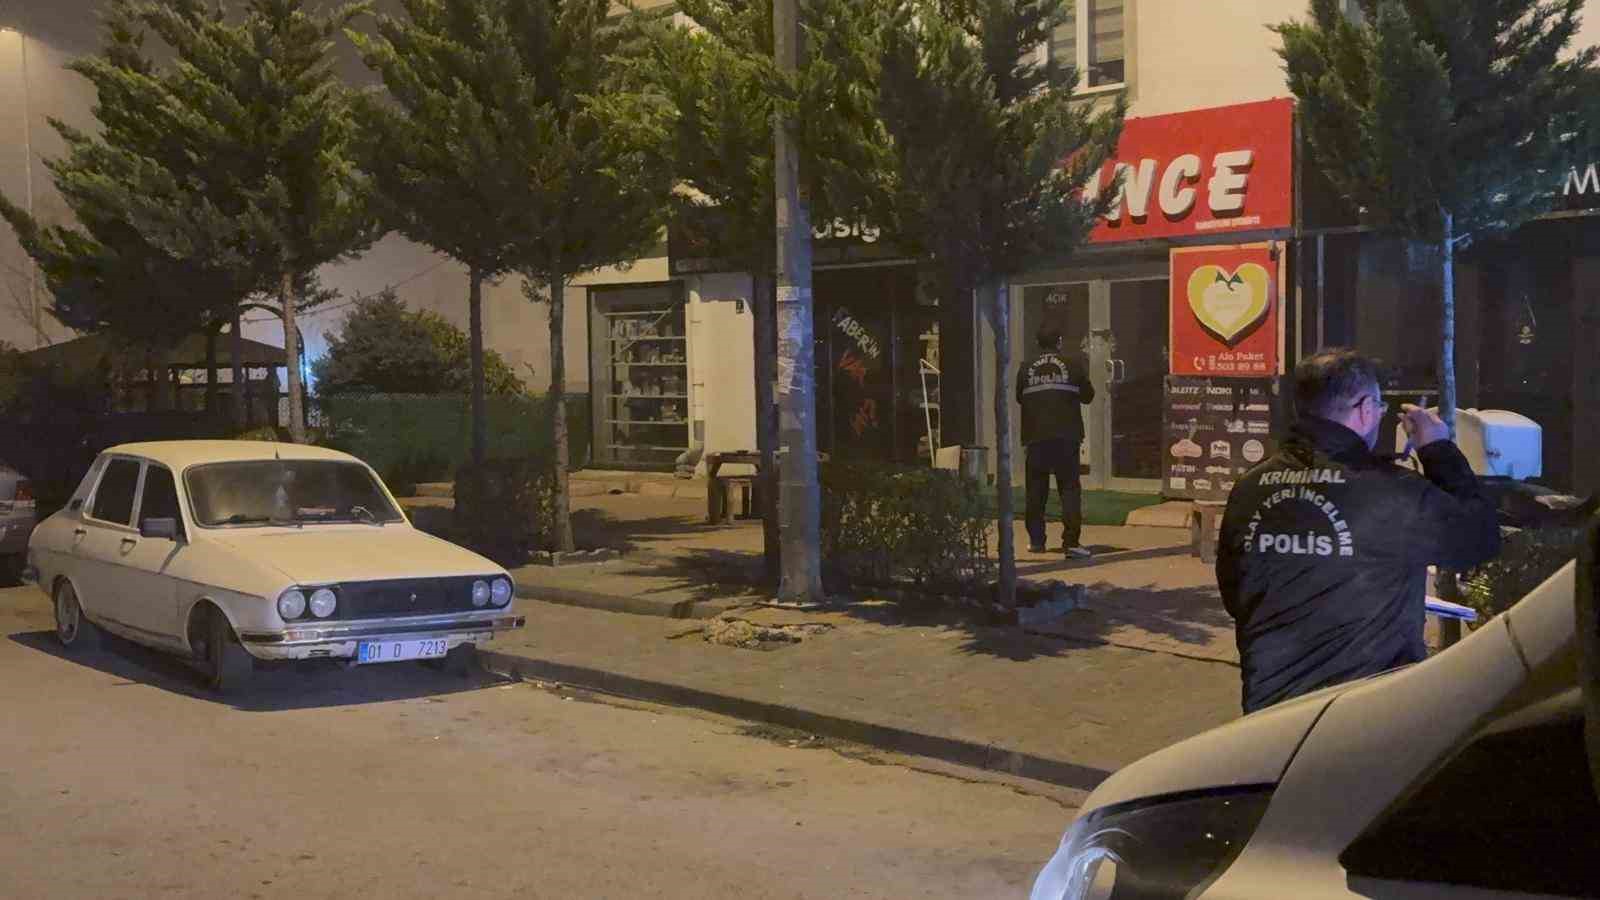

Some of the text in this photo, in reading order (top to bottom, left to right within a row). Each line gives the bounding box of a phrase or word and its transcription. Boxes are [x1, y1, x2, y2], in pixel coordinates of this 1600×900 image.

[1259, 468, 1346, 485] KRİMİNAL
[1243, 486, 1355, 557] OLAY YERİ İNCELEME
[1258, 531, 1333, 557] POLİS
[369, 645, 382, 660] 01
[418, 641, 447, 655] 7213
